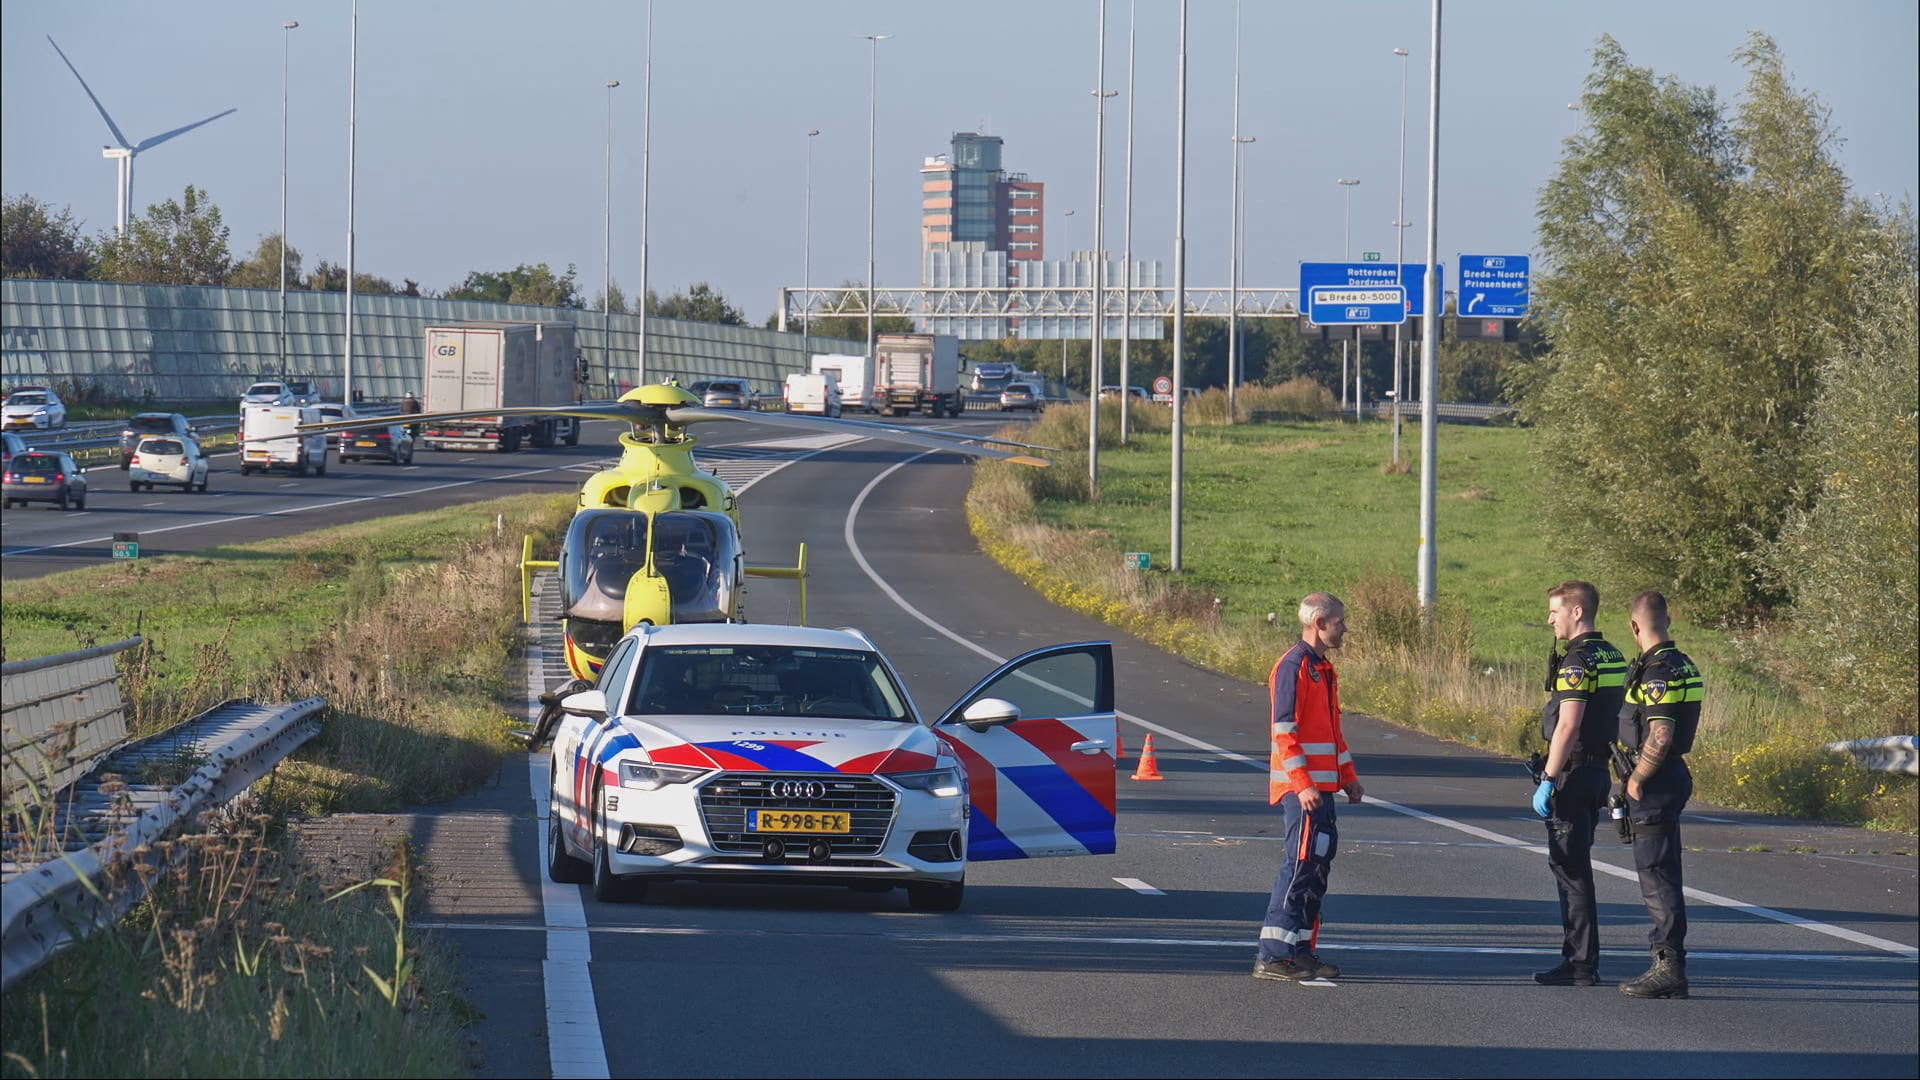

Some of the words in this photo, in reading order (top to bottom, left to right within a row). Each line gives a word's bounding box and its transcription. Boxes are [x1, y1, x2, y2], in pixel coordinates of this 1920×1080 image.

[1347, 268, 1396, 277] Rotterdam
[1348, 278, 1395, 286] Dordrecht
[1465, 280, 1523, 288] Prinsenbeek
[1329, 293, 1357, 301] Breda
[1359, 292, 1398, 301] 0-5000
[437, 345, 457, 356] GB
[732, 740, 766, 751] 1299
[762, 813, 842, 830] R-998-FX
